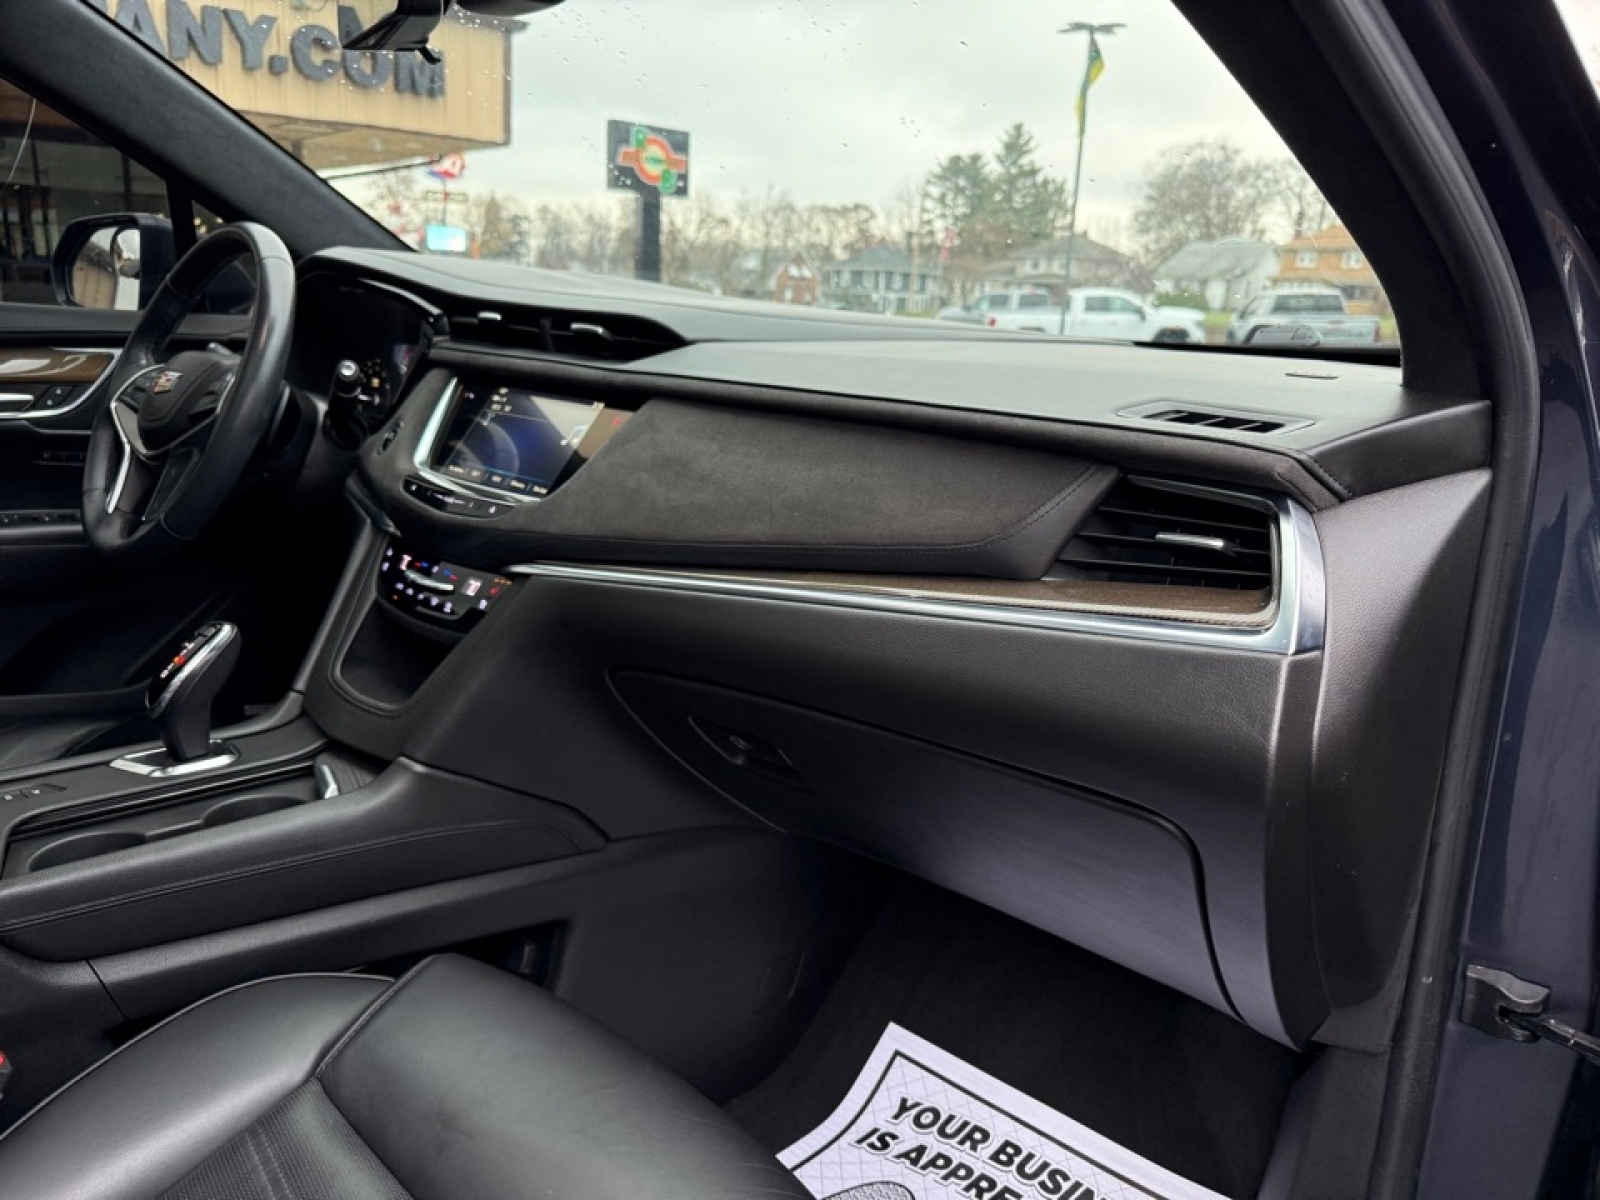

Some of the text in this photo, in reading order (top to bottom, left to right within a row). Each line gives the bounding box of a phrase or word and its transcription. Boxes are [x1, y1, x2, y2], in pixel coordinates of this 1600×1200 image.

[100, 0, 445, 98] ANY.COM
[855, 1127, 899, 1151] IS
[891, 1097, 991, 1152] YOUR
